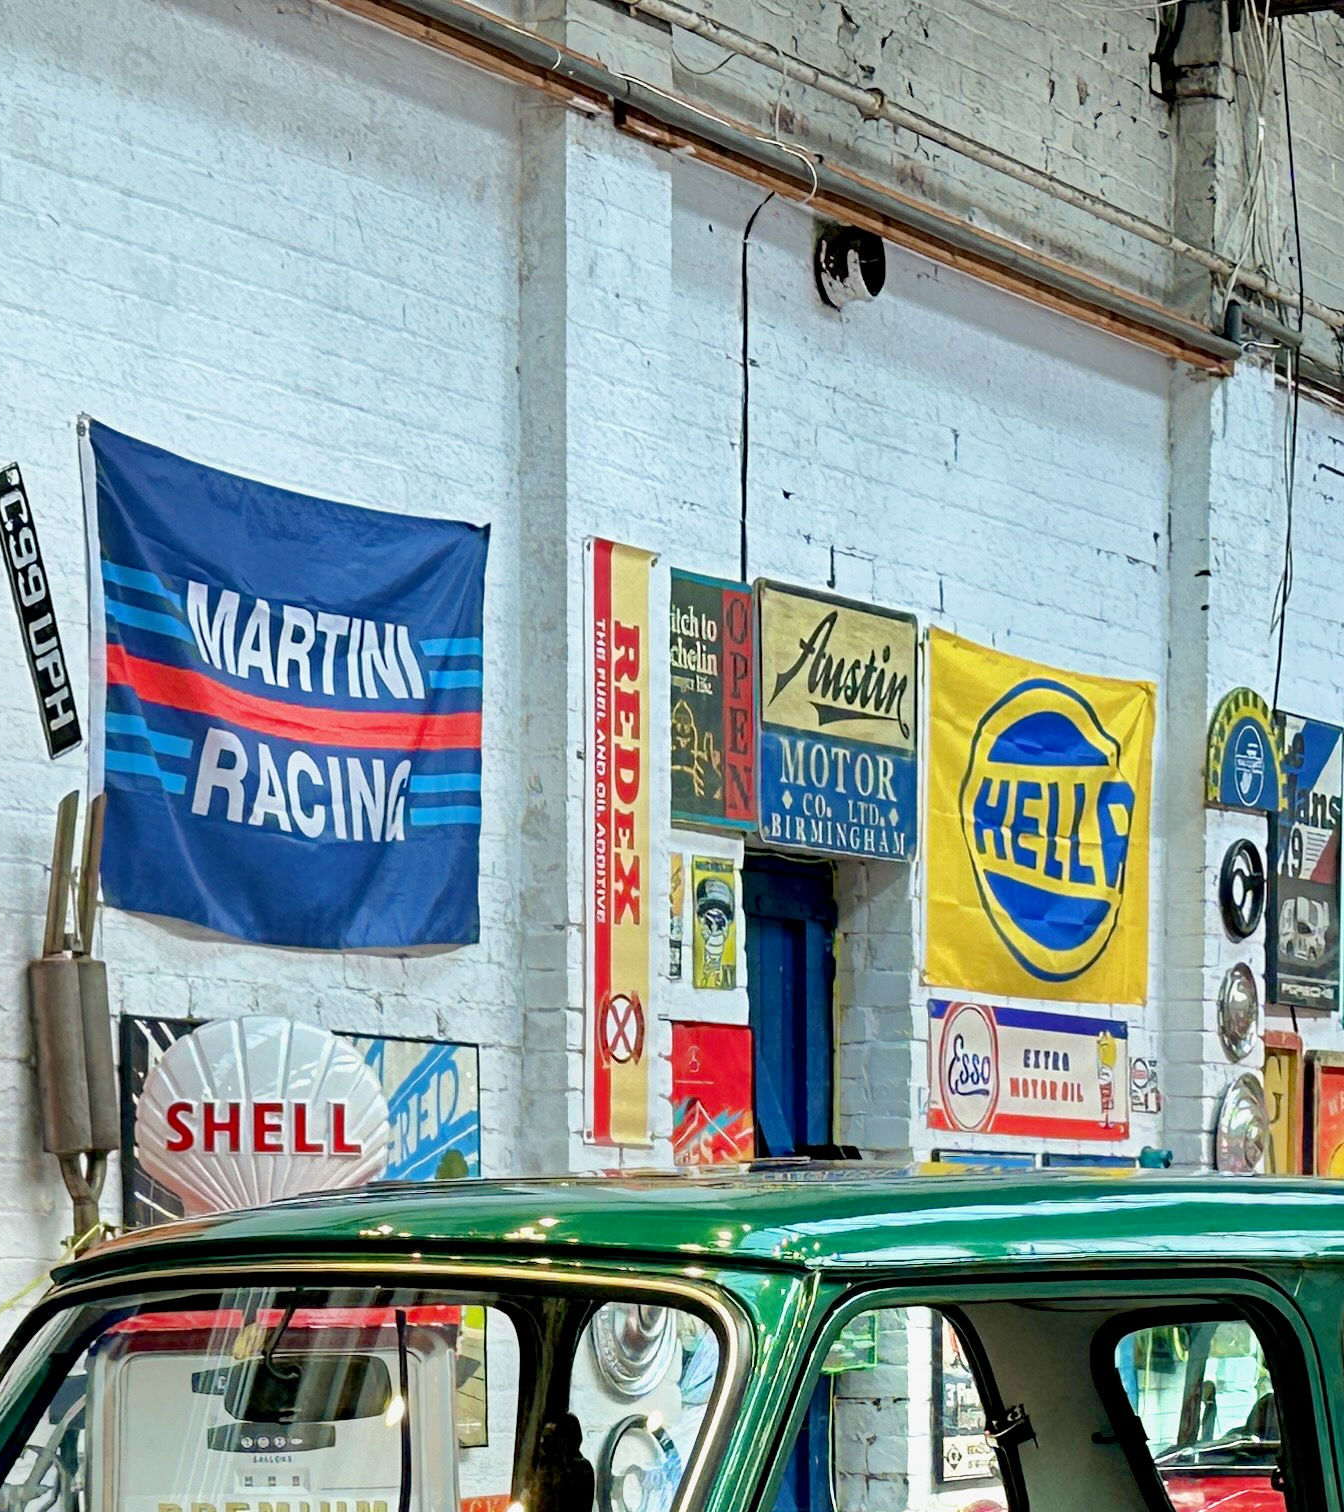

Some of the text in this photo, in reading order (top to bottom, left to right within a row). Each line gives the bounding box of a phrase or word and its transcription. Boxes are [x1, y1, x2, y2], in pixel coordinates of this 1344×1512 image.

[0, 491, 75, 731] C99 UPH
[186, 581, 425, 699] MARTINI
[701, 613, 717, 642] to
[725, 598, 752, 811] OPEN
[767, 611, 910, 739] Austin
[191, 727, 412, 842] RACING
[594, 618, 607, 925] THE FUEL AND OIL ADDITIVE
[613, 620, 641, 926] REDEX
[779, 736, 898, 802] MOTOR
[771, 812, 905, 856] BIRMINGHAM
[802, 793, 886, 827] CO. LTD.
[948, 1033, 991, 1096] Esso
[1009, 1077, 1084, 1102] MOTOR OIL
[1023, 1048, 1070, 1072] EXTRA
[166, 1101, 362, 1154] SHELL
